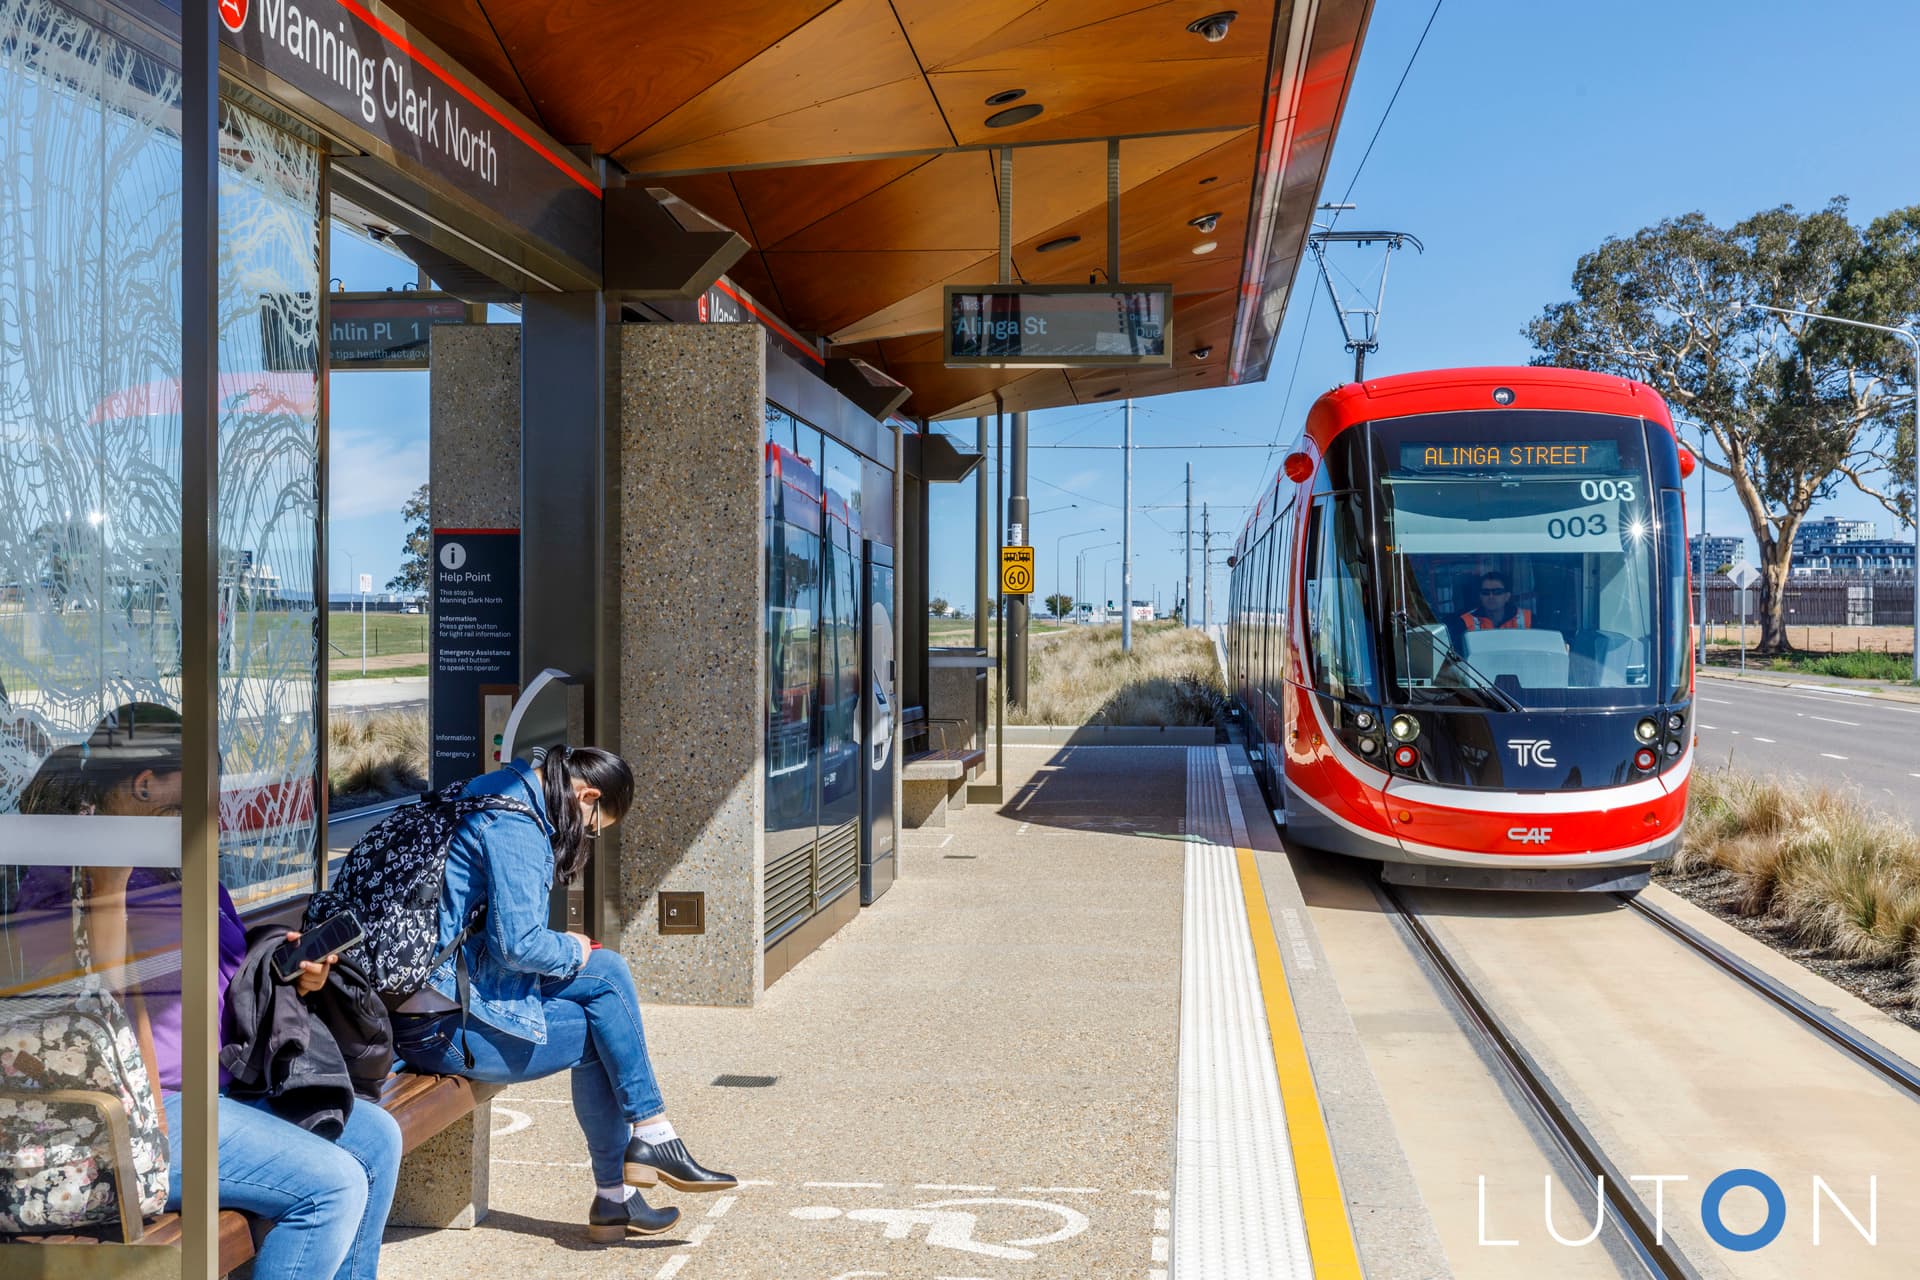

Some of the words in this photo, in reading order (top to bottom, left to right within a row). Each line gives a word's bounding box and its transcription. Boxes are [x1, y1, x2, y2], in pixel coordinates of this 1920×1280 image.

[259, 0, 376, 124] Manning
[381, 56, 440, 148] Clark
[445, 99, 498, 187] North
[329, 322, 368, 341] hlin
[374, 322, 393, 341] Pl
[411, 321, 420, 341] 1
[956, 315, 1020, 340] Alinga
[1024, 315, 1048, 336] St
[1136, 327, 1161, 338] Due
[1424, 446, 1501, 466] ALINGA
[1510, 445, 1590, 465] STREET
[1580, 479, 1636, 502] 003
[1547, 513, 1608, 540] 003
[439, 572, 463, 584] Help
[465, 572, 492, 582] Point
[1008, 570, 1025, 585] 60
[439, 597, 467, 605] Manning
[453, 589, 467, 597] stop
[439, 649, 475, 657] Emergency
[447, 664, 466, 672] speak
[1507, 739, 1557, 768] TC
[1507, 827, 1553, 845] CAF
